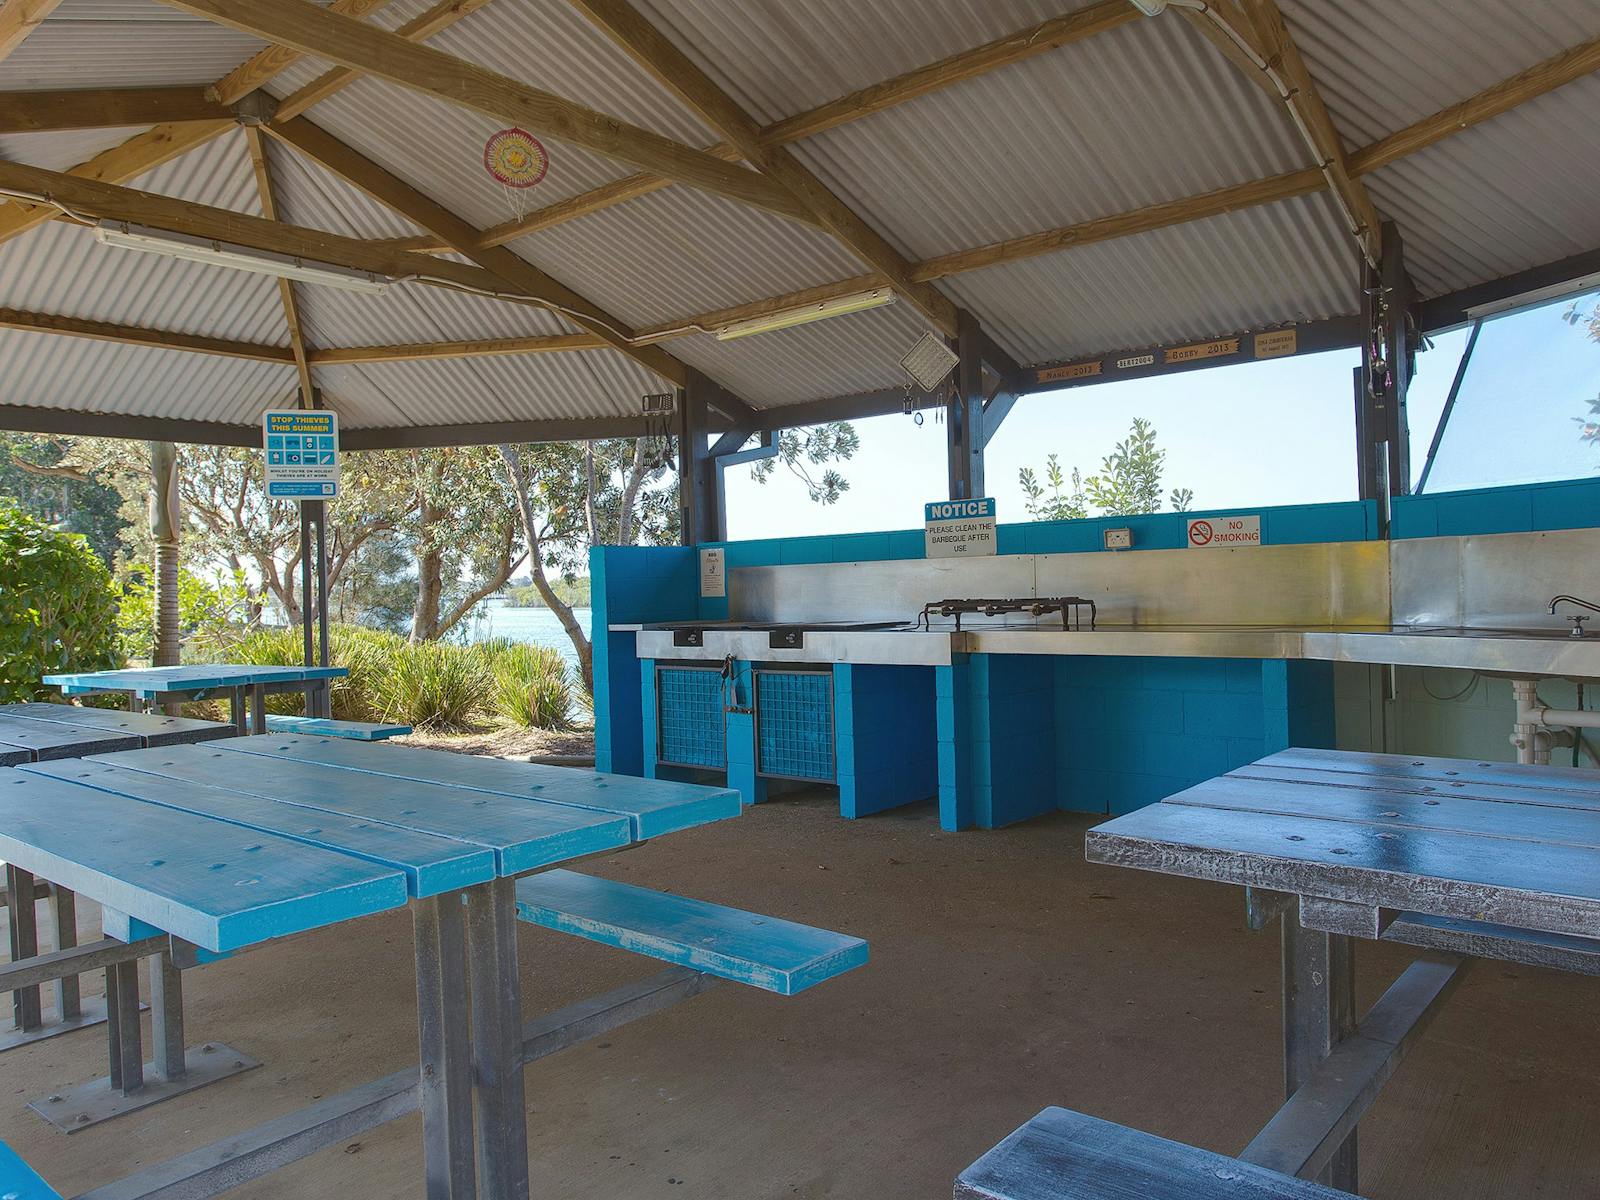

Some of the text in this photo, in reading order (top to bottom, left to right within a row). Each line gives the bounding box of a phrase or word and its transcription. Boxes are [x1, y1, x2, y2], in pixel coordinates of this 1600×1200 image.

[1207, 343, 1230, 354] 2013
[295, 416, 330, 424] THIEVES
[931, 501, 988, 518] NOTICE
[929, 522, 992, 534] PLEASE CLEAN THE
[1229, 521, 1243, 530] NO
[931, 533, 990, 544] BARBEQUE AFTER
[1214, 532, 1259, 542] SMOKING
[953, 544, 967, 552] USE
